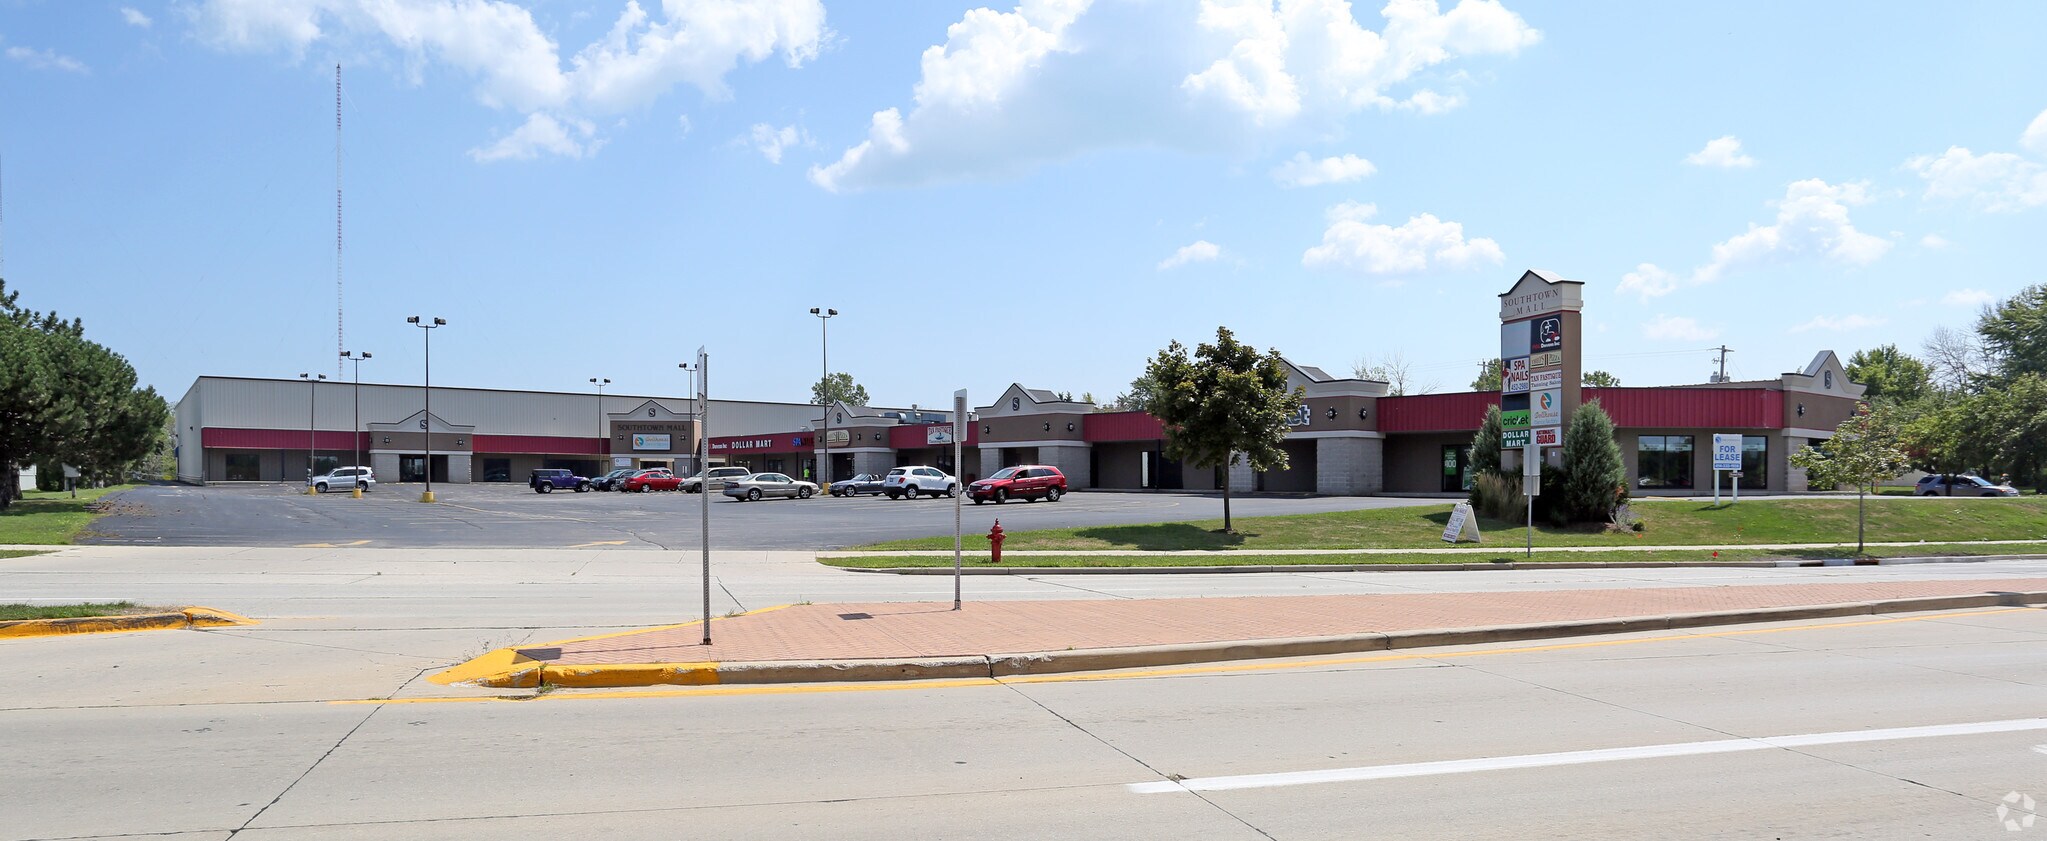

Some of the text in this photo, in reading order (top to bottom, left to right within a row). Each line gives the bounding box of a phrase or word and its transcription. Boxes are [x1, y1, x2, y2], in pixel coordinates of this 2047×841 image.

[1503, 289, 1559, 308] SOUTHTOWN
[1516, 302, 1545, 315] MALL
[1514, 360, 1526, 371] SPA
[1510, 370, 1529, 382] NAILS
[1531, 374, 1540, 382] TAN
[1502, 415, 1529, 426] cricket
[1502, 430, 1529, 439] DOLLAR
[1536, 434, 1556, 445] GUARD
[731, 440, 754, 449] DOLLAR
[755, 439, 772, 448] MART
[792, 437, 802, 447] SPA
[1506, 439, 1526, 447] MART
[1714, 453, 1741, 461] LEASE
